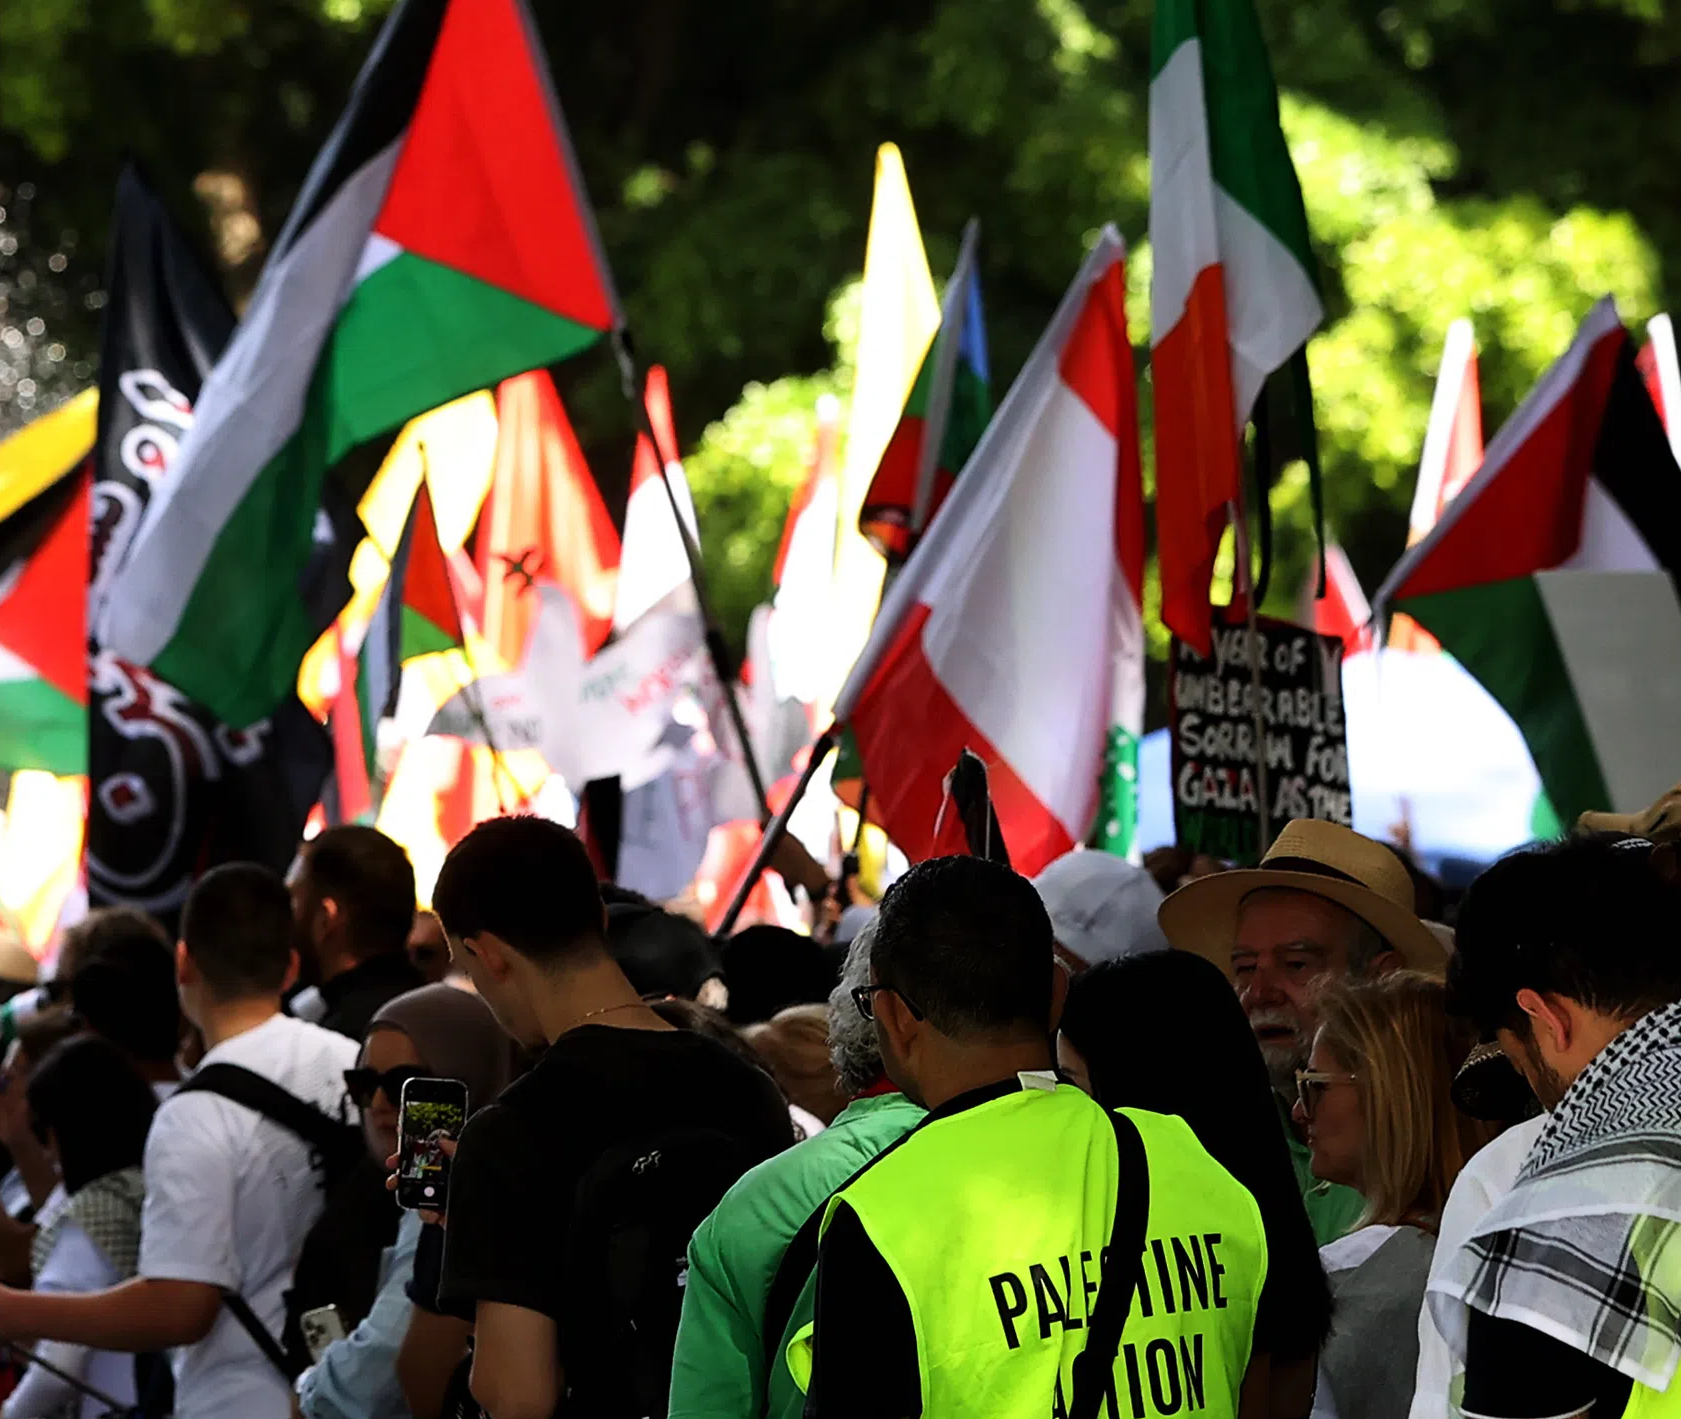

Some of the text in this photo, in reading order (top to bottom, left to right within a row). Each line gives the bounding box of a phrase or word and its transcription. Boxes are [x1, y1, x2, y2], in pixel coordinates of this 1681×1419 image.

[1177, 711, 1295, 773] SORRW
[1178, 760, 1259, 814] GAZA
[1273, 775, 1308, 821] AS
